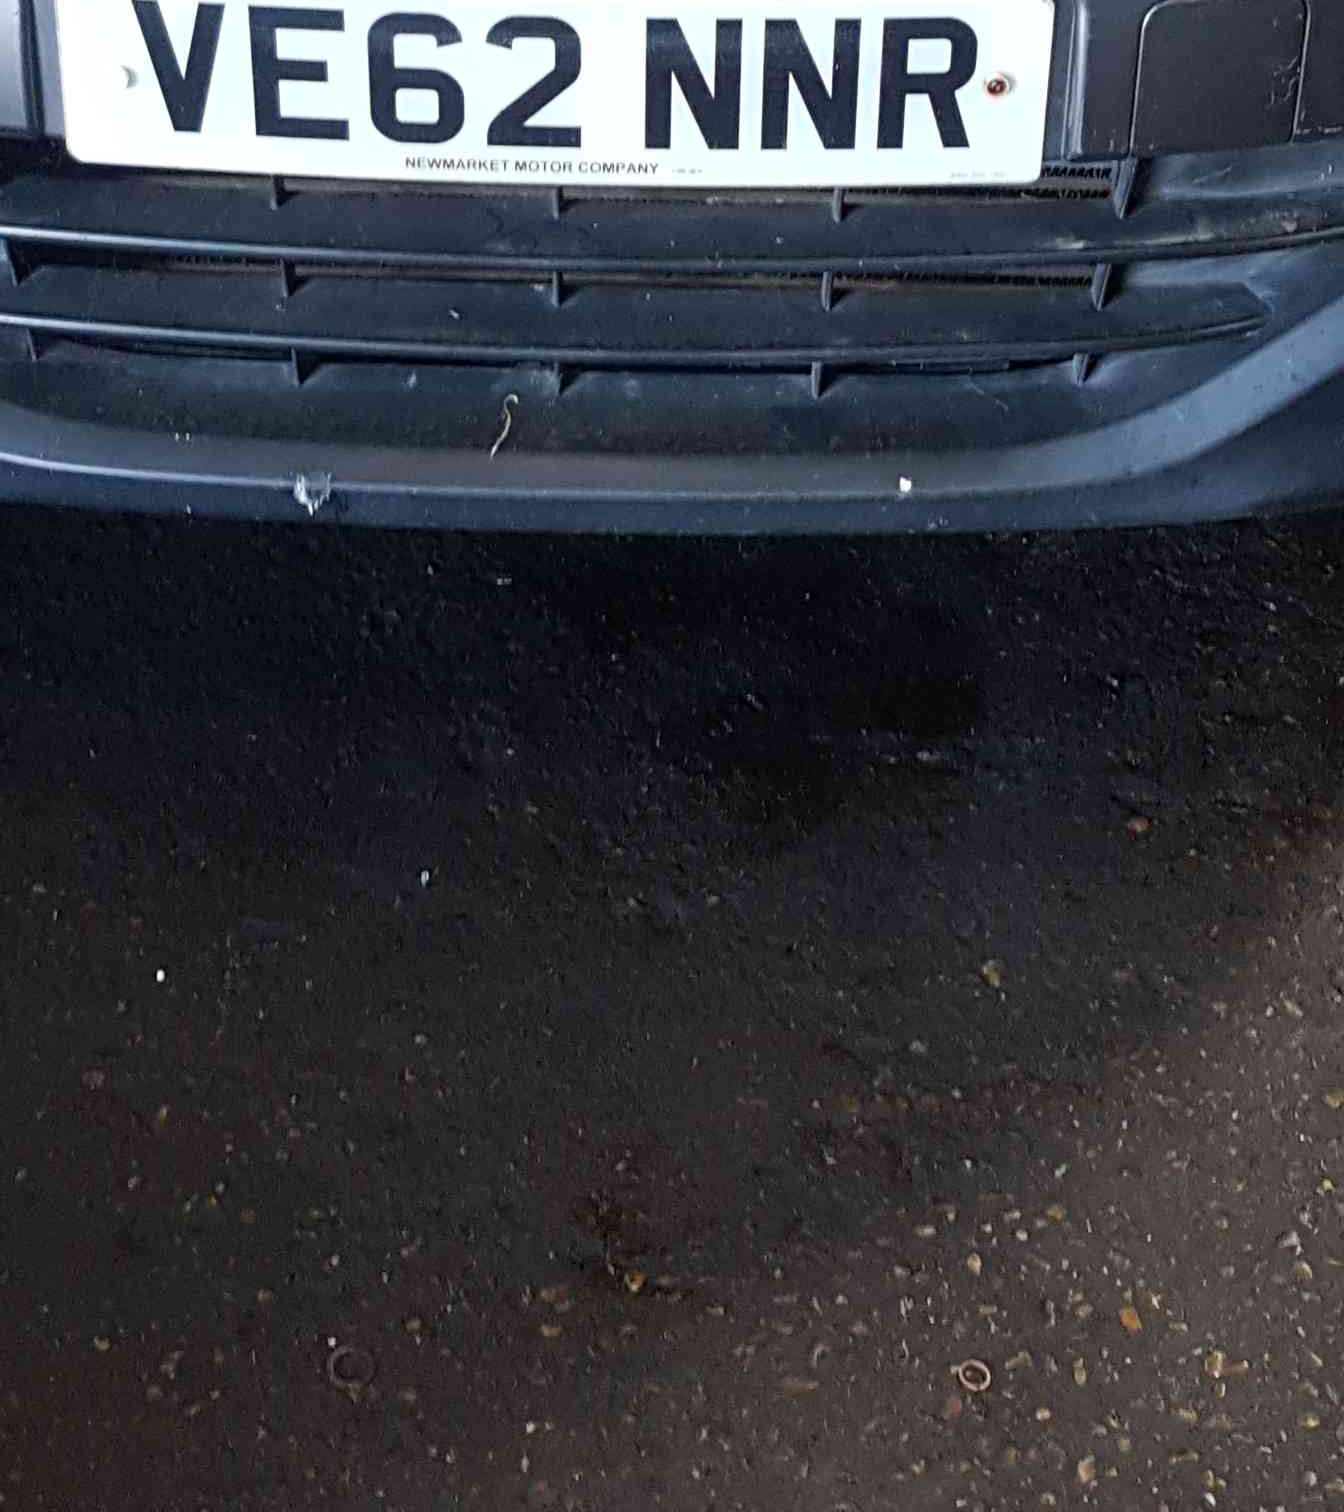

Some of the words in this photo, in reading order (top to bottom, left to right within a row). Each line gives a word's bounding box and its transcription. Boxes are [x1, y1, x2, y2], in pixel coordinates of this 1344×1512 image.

[644, 16, 978, 150] NNR
[404, 156, 509, 173] NEWMARKET
[513, 159, 574, 174] MOTOR
[577, 160, 659, 176] COMPANY
